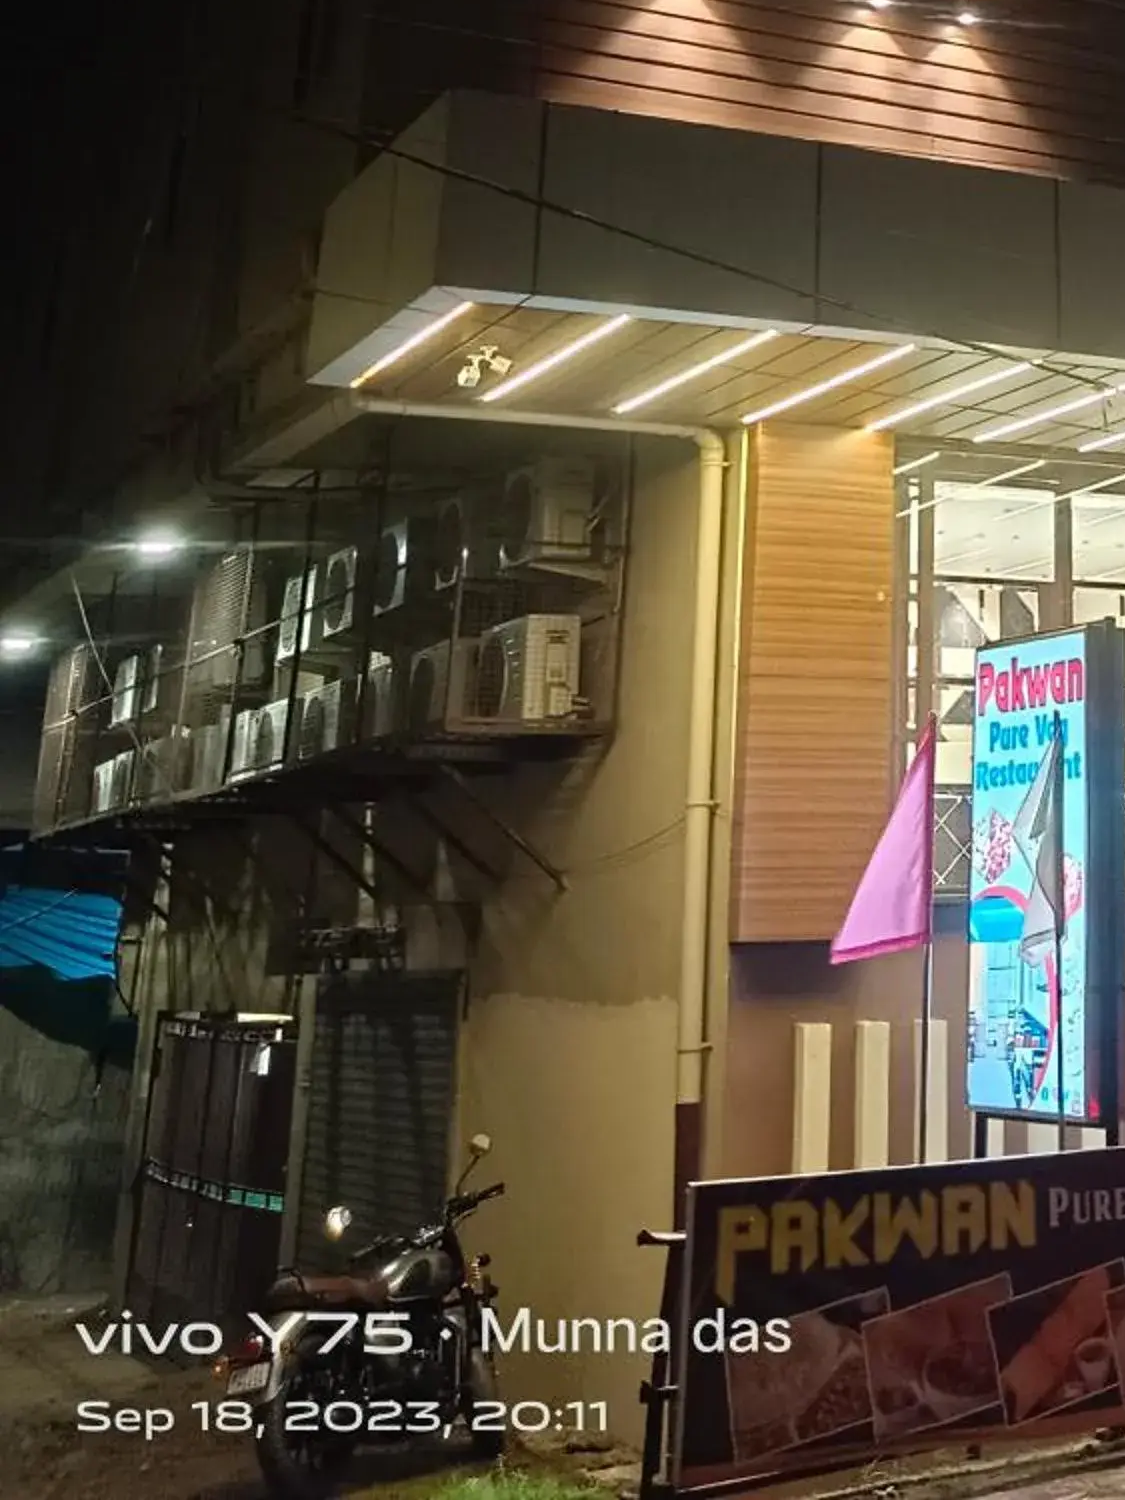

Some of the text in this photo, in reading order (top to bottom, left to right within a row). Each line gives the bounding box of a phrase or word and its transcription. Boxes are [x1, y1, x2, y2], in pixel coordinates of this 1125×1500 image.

[977, 657, 1083, 716] Pakwan
[989, 721, 1029, 753] Pure
[715, 1180, 1036, 1308] PAKWAN
